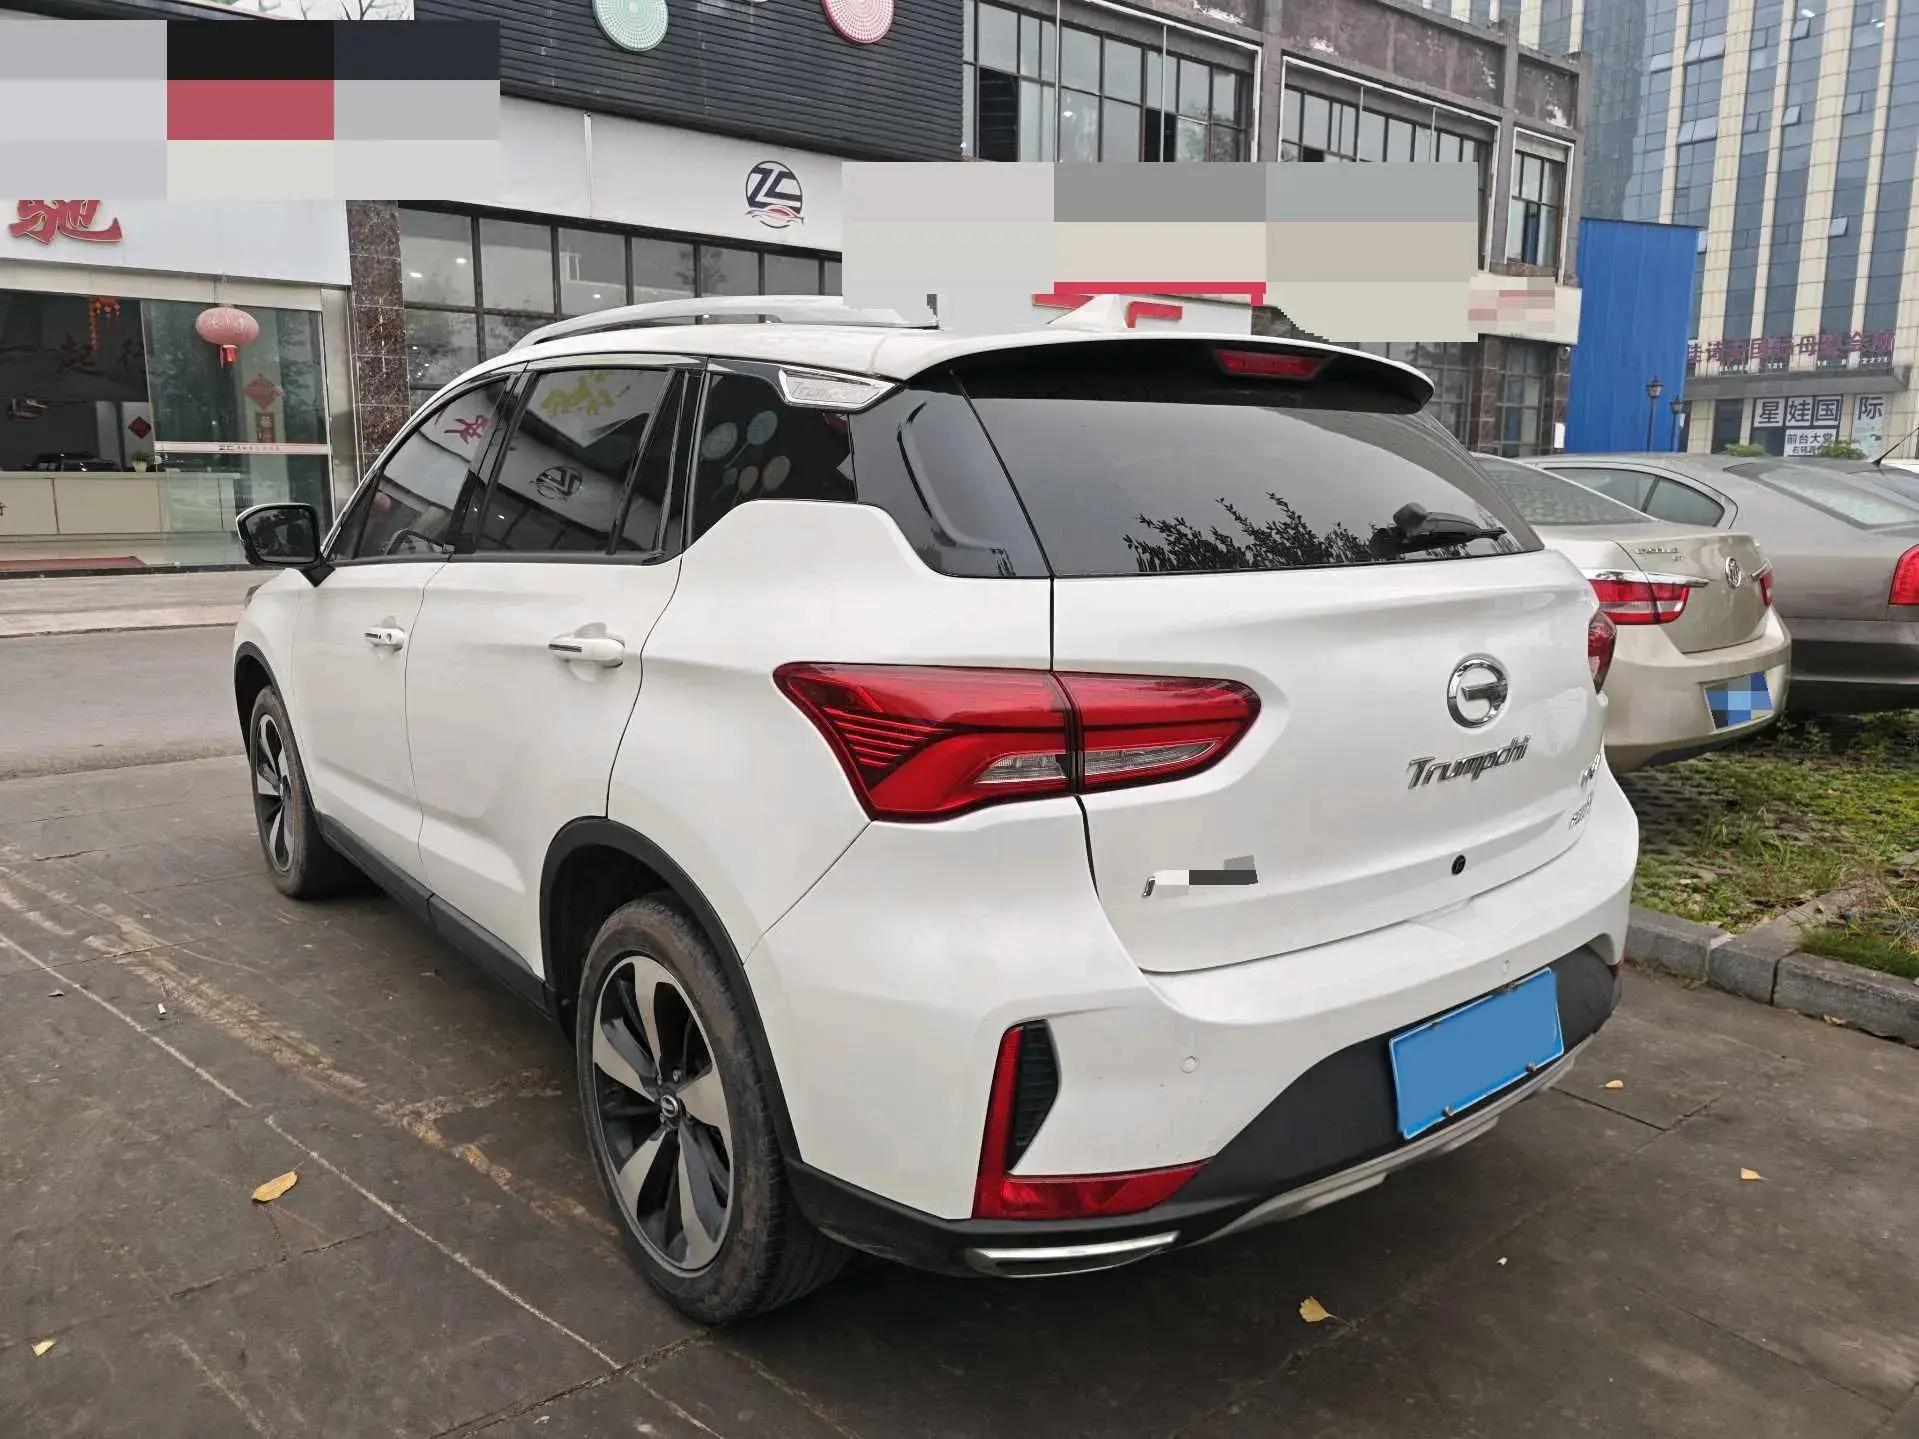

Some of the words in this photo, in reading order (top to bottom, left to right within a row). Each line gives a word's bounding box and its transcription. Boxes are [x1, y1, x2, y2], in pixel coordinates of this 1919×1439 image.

[1758, 396, 1883, 424] 星娃国际
[1407, 735, 1531, 789] Trumpchi
